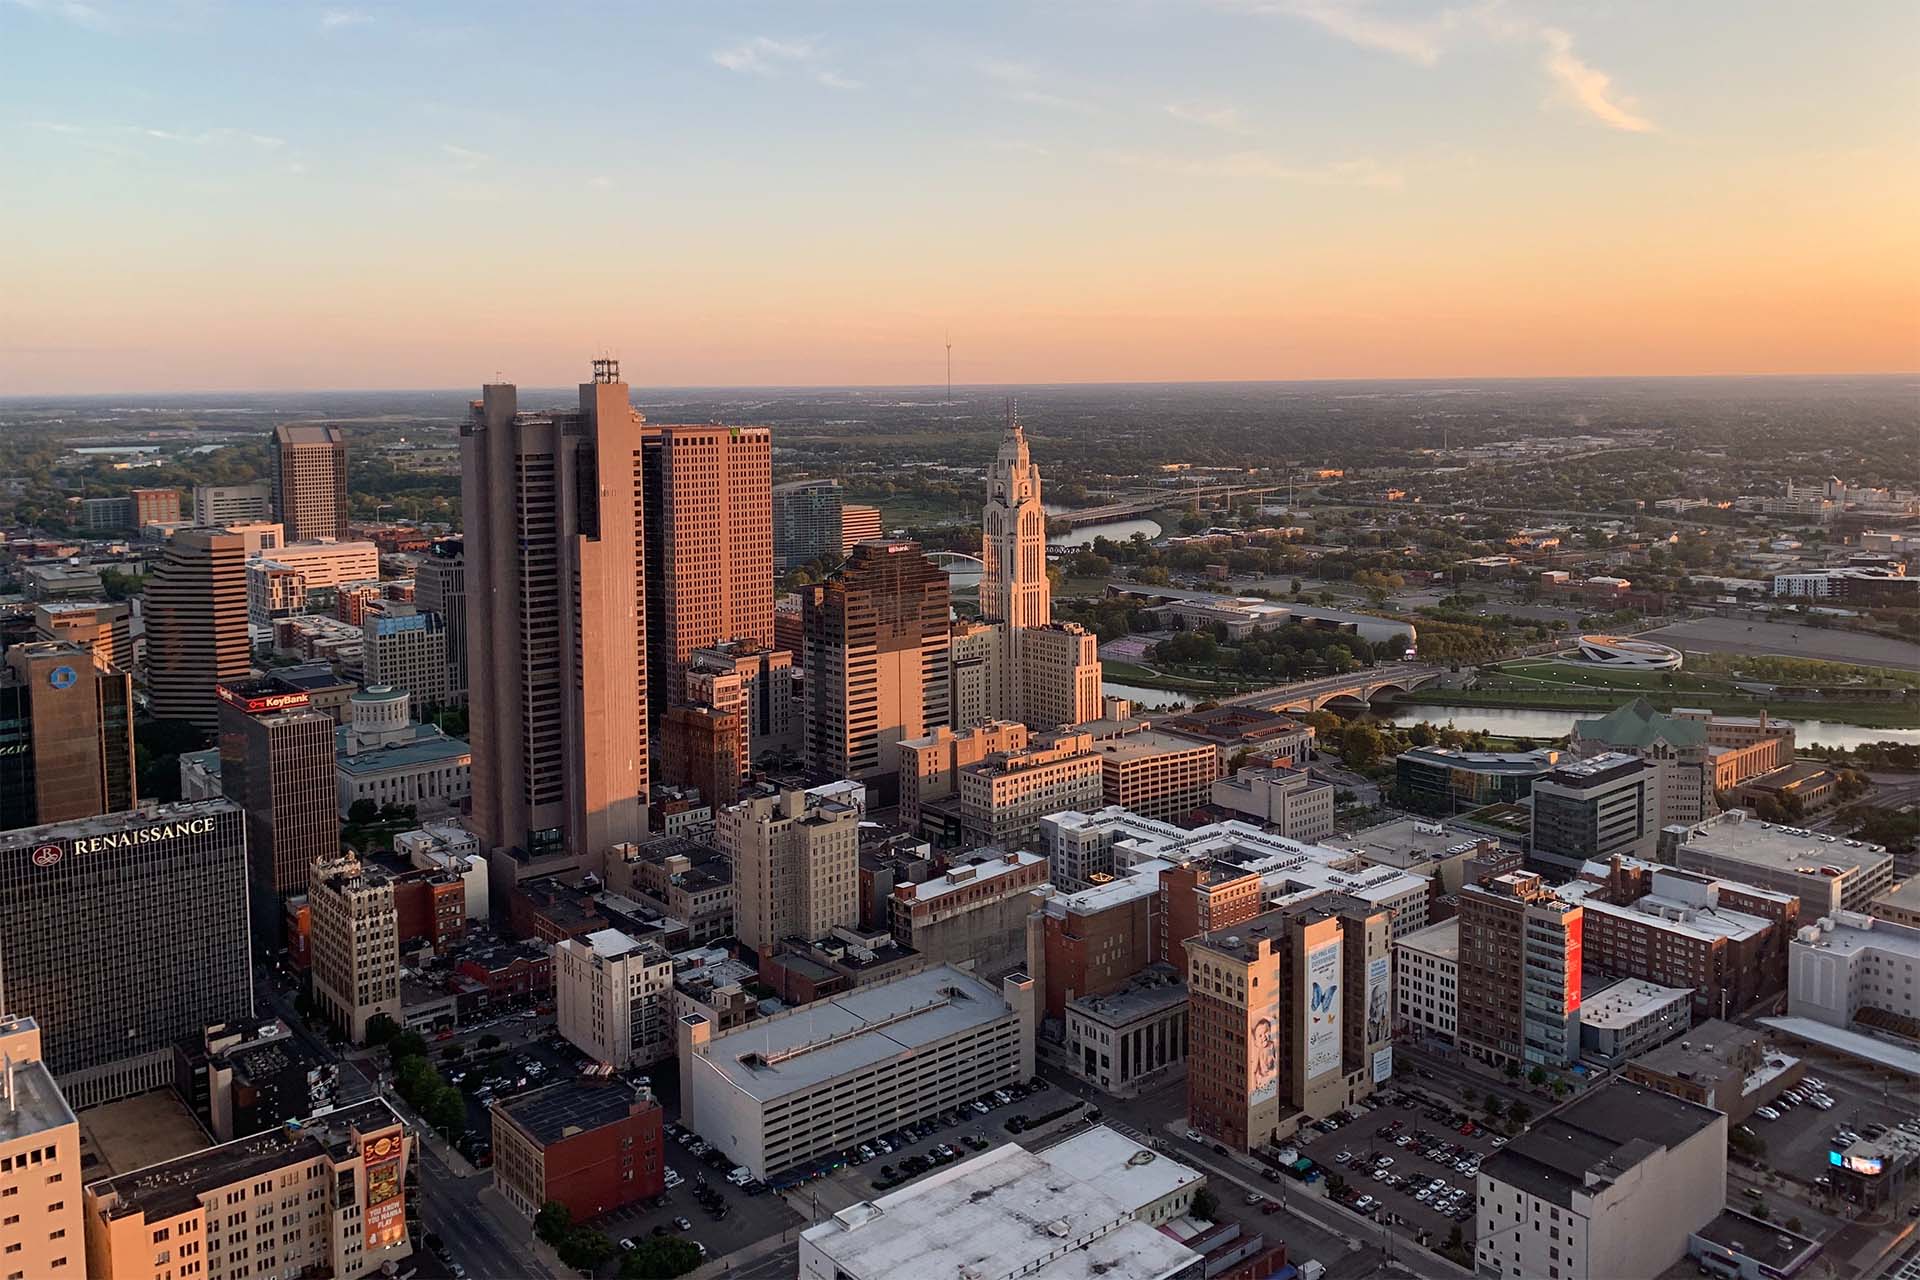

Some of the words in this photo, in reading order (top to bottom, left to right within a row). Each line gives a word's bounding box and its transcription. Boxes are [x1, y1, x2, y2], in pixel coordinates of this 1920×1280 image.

[265, 693, 309, 707] KeyBank
[74, 817, 216, 856] RENAISSANCE
[378, 1218, 393, 1229] PLAY
